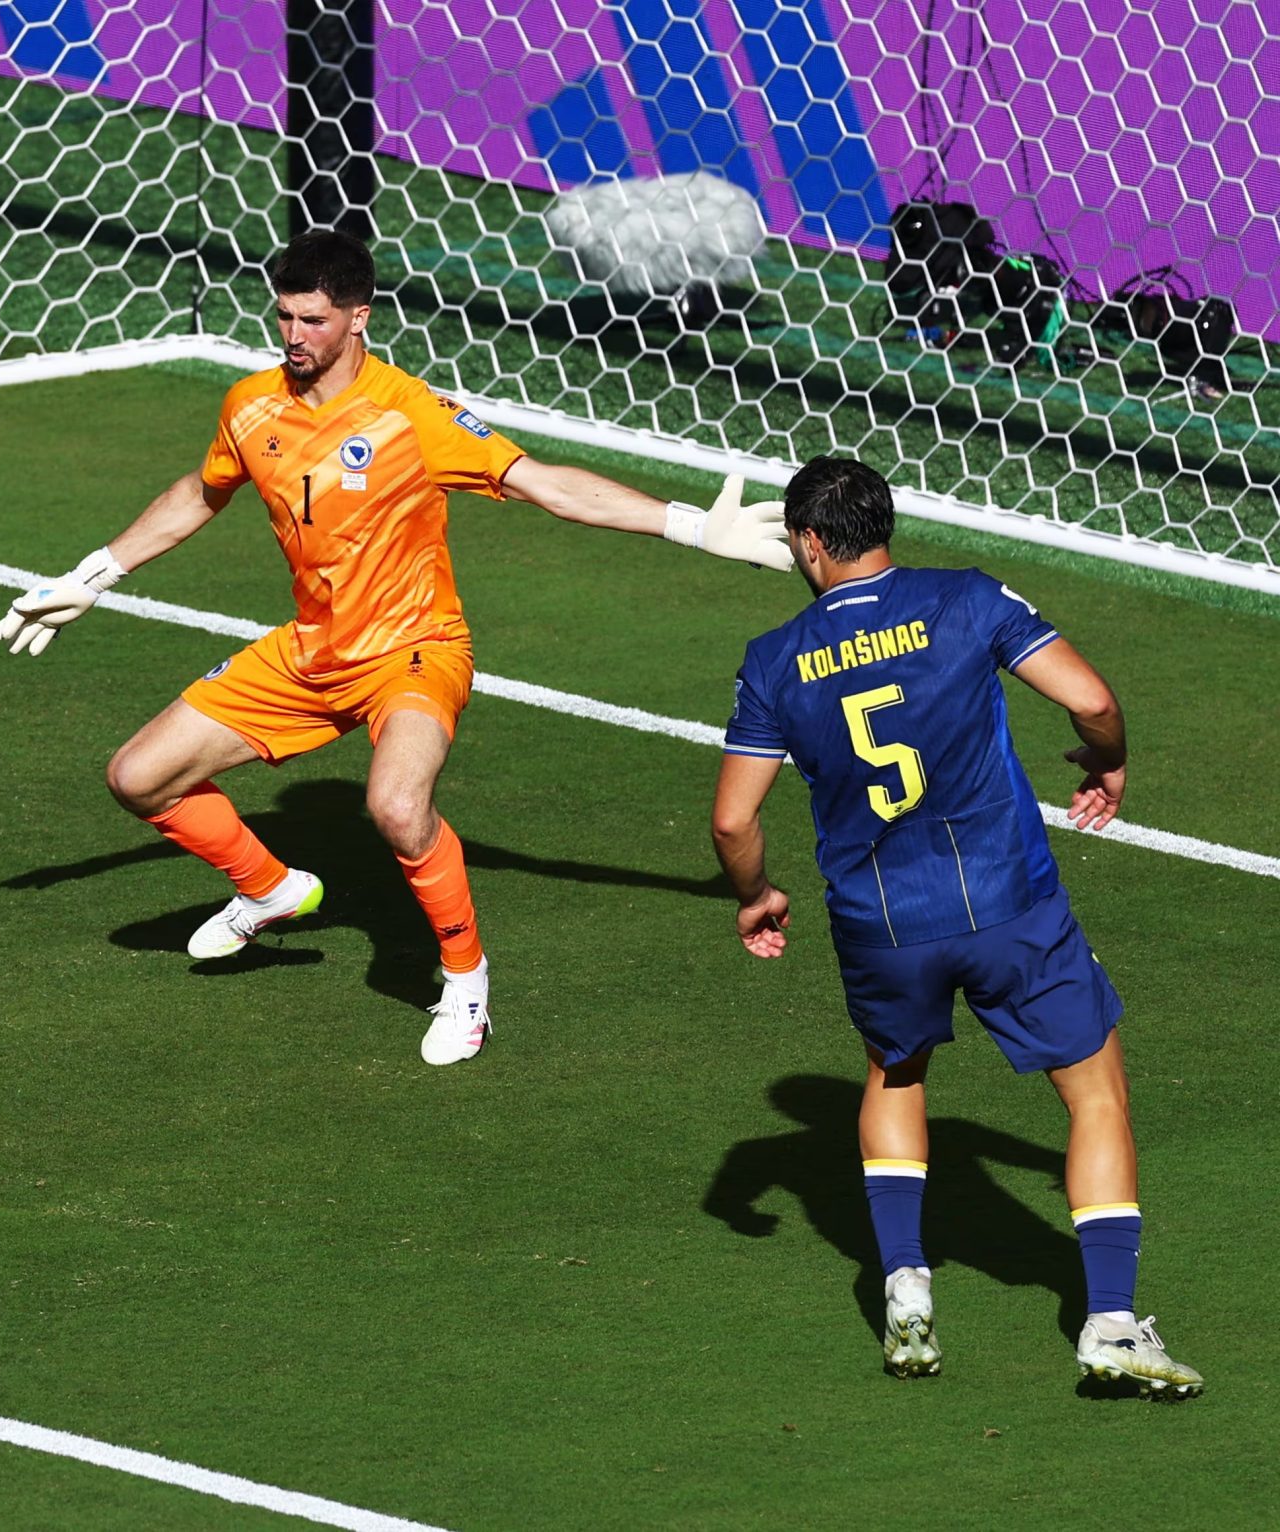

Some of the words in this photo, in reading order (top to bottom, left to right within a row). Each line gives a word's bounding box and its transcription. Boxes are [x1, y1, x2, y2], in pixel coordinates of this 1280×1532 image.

[302, 474, 314, 526] 1
[796, 620, 929, 683] KOLAŠINAC
[841, 684, 927, 823] 5
